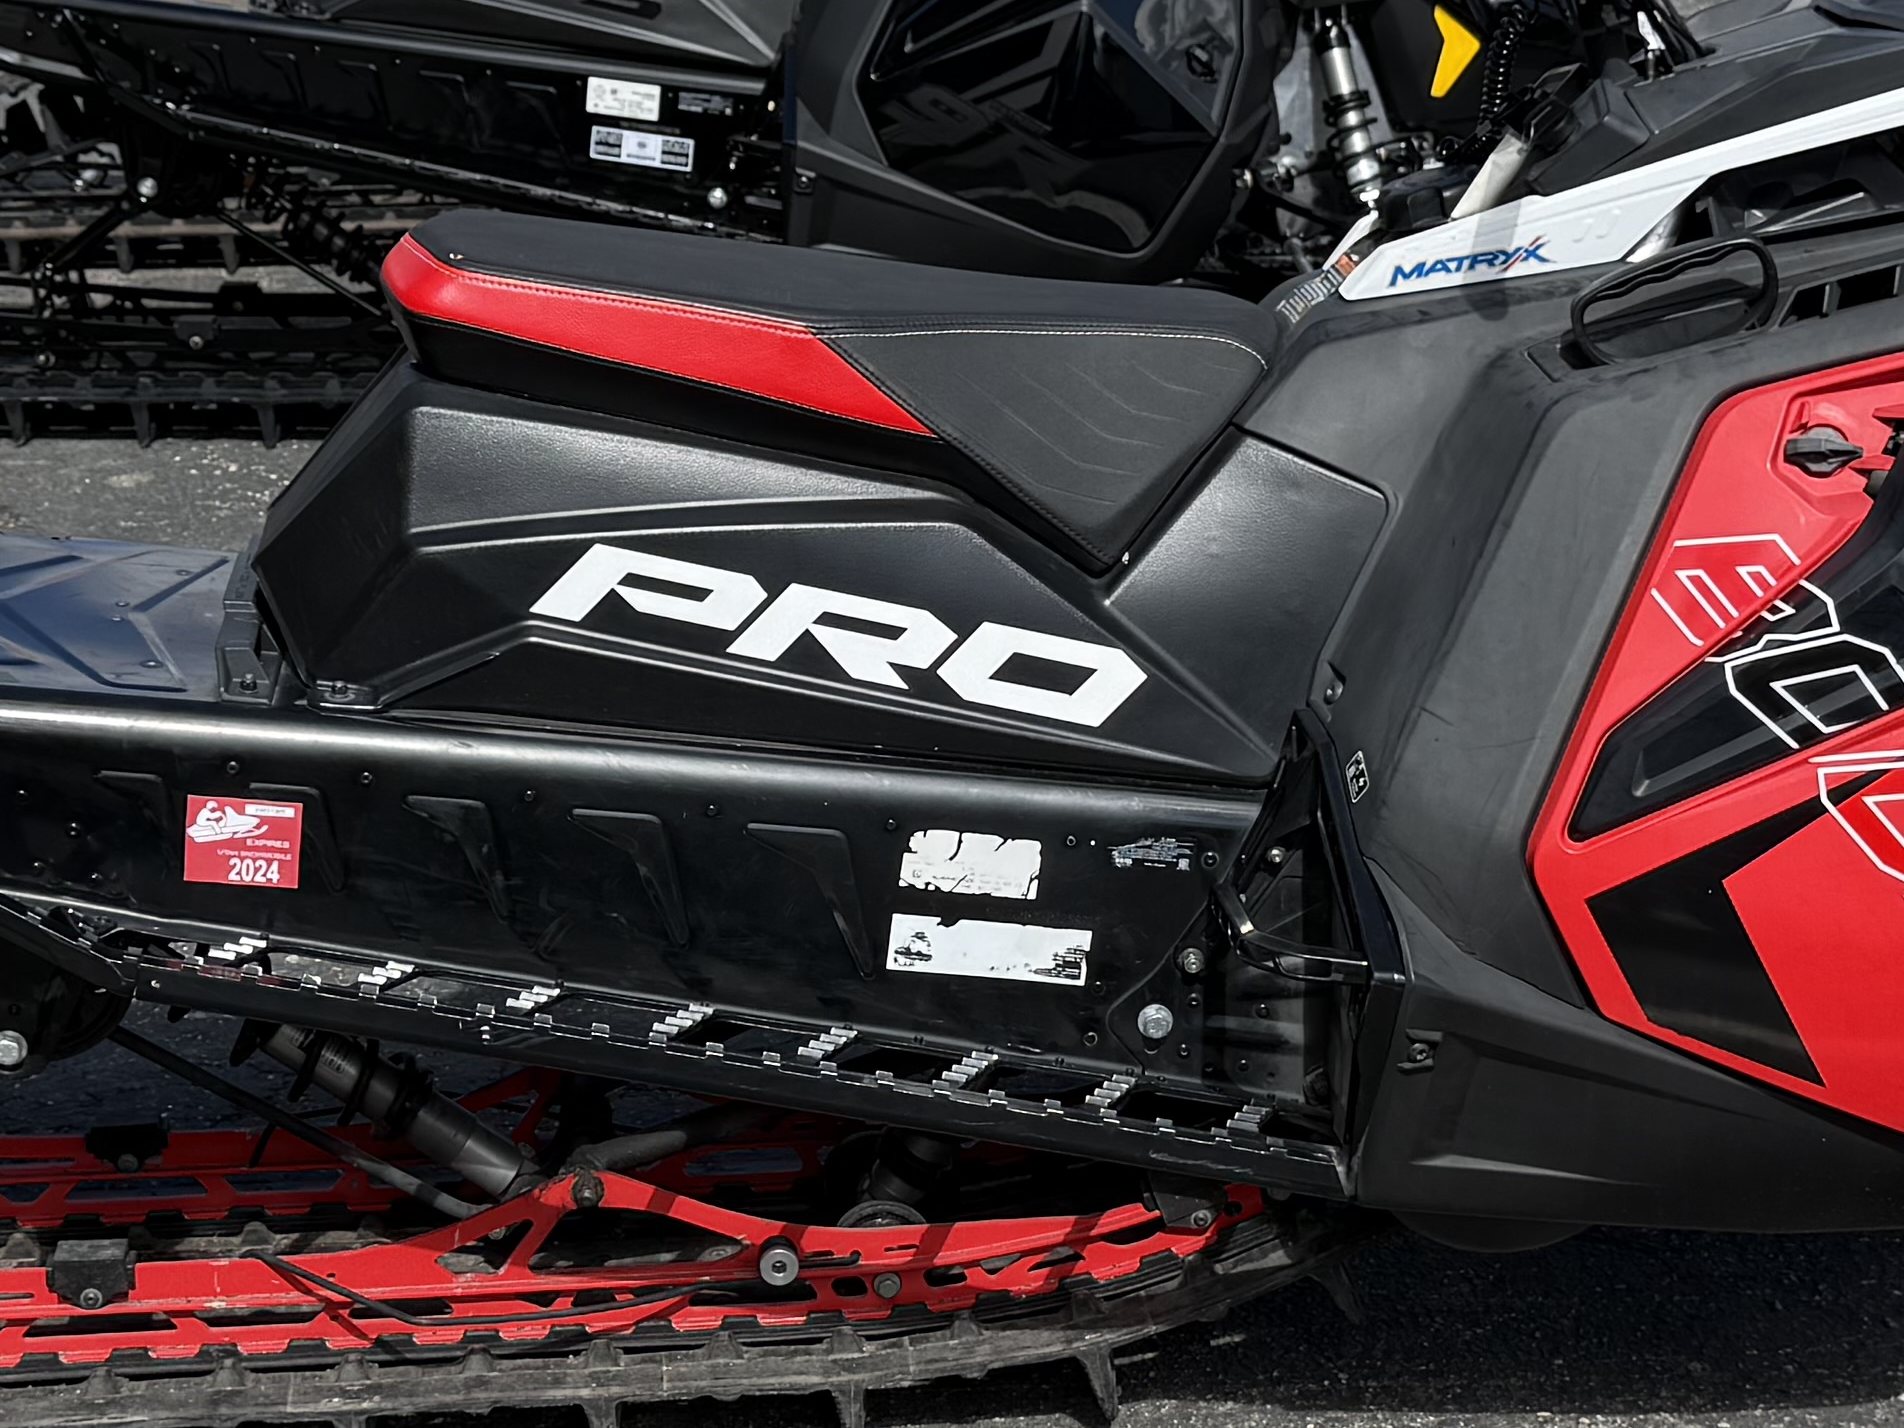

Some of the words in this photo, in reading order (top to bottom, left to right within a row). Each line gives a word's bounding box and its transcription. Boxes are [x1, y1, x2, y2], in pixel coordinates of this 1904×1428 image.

[1386, 235, 1557, 289] MATRYX
[528, 543, 1148, 728] PRO
[227, 856, 281, 885] 2024
